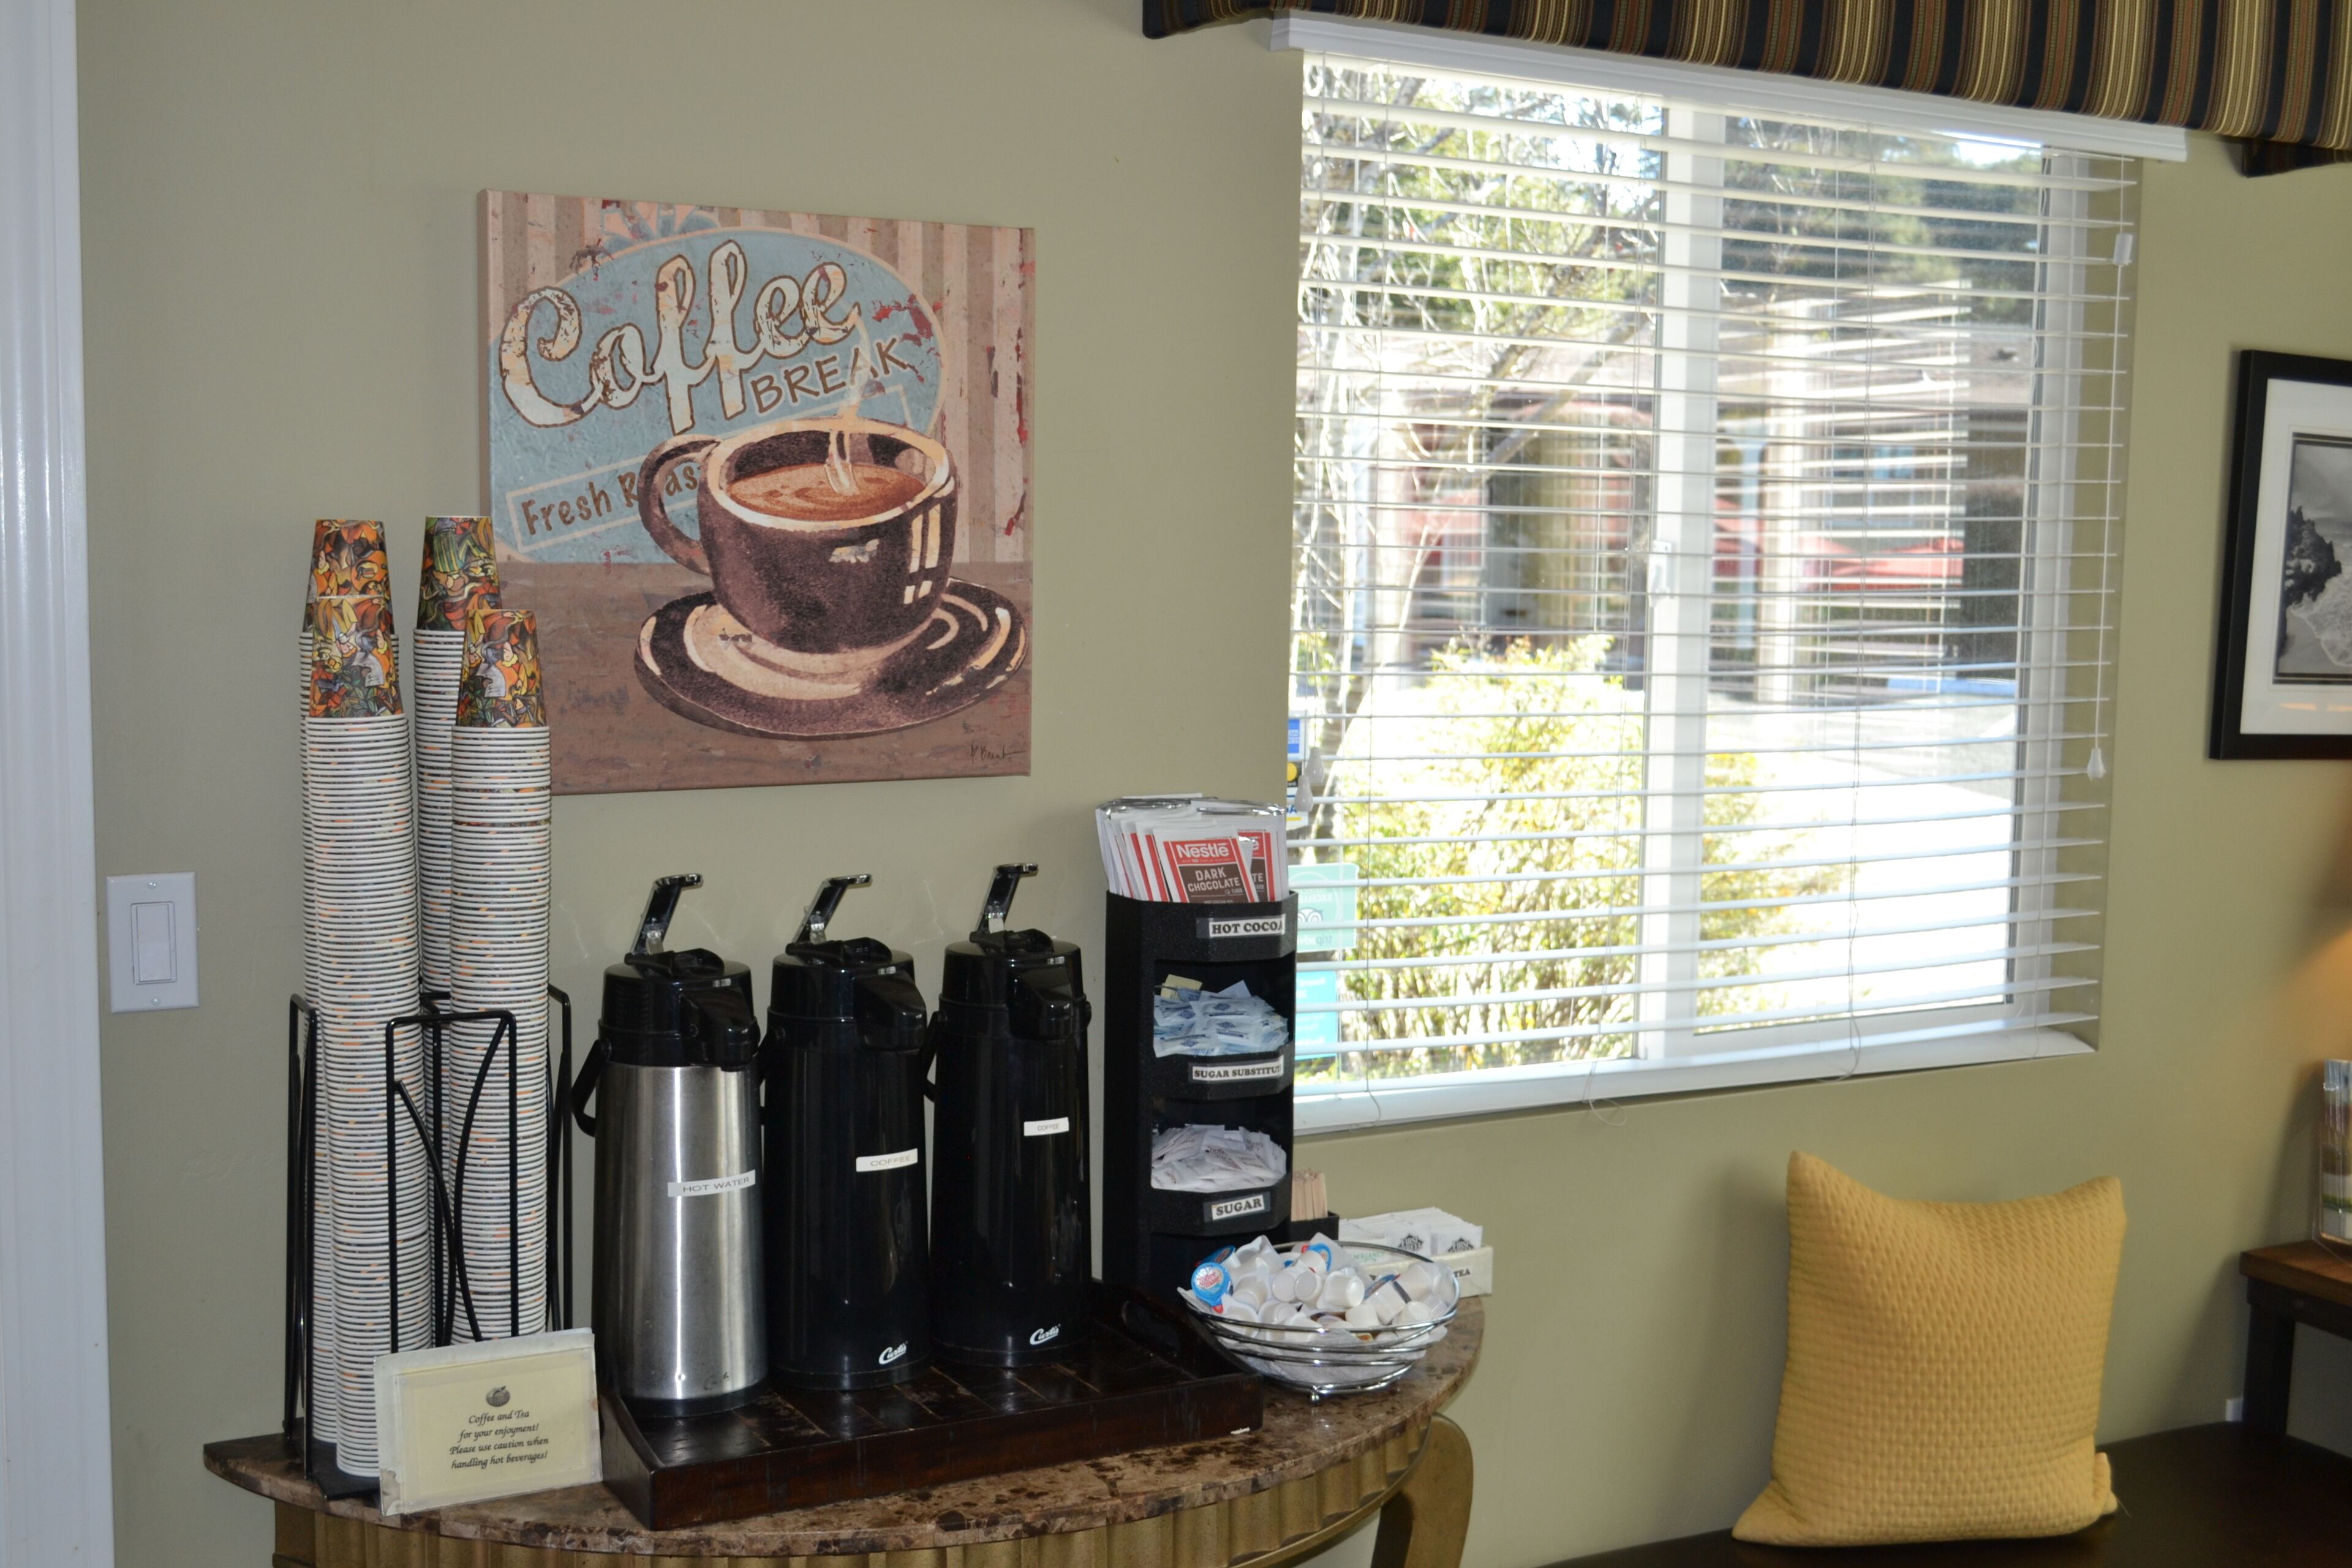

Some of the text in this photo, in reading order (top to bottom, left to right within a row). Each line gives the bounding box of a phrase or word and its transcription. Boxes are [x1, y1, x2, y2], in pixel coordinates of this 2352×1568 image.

[499, 239, 861, 435] Coffee
[750, 338, 910, 413] BREAK
[521, 466, 702, 535] Fresh Ras
[1196, 867, 1226, 881] DARK
[1188, 877, 1240, 892] CHOCOLATE
[1211, 920, 1283, 934] HOT COCOA
[1194, 1068, 1230, 1078] SUGAR
[1037, 1123, 1060, 1131] COFFEE
[870, 1155, 911, 1167] COFFEE
[714, 1177, 749, 1189] WATER
[1216, 1197, 1262, 1216] SUGAR
[1453, 1268, 1471, 1278] TEA
[1030, 1325, 1059, 1345] Curtis
[879, 1343, 907, 1365] Curtis
[469, 1409, 529, 1426] Coffee and Tea
[458, 1423, 539, 1443] for your enjoyment!
[450, 1445, 477, 1455] Please
[494, 1439, 524, 1450] caution
[527, 1436, 549, 1446] when
[451, 1450, 548, 1469] handling hot beverages!
